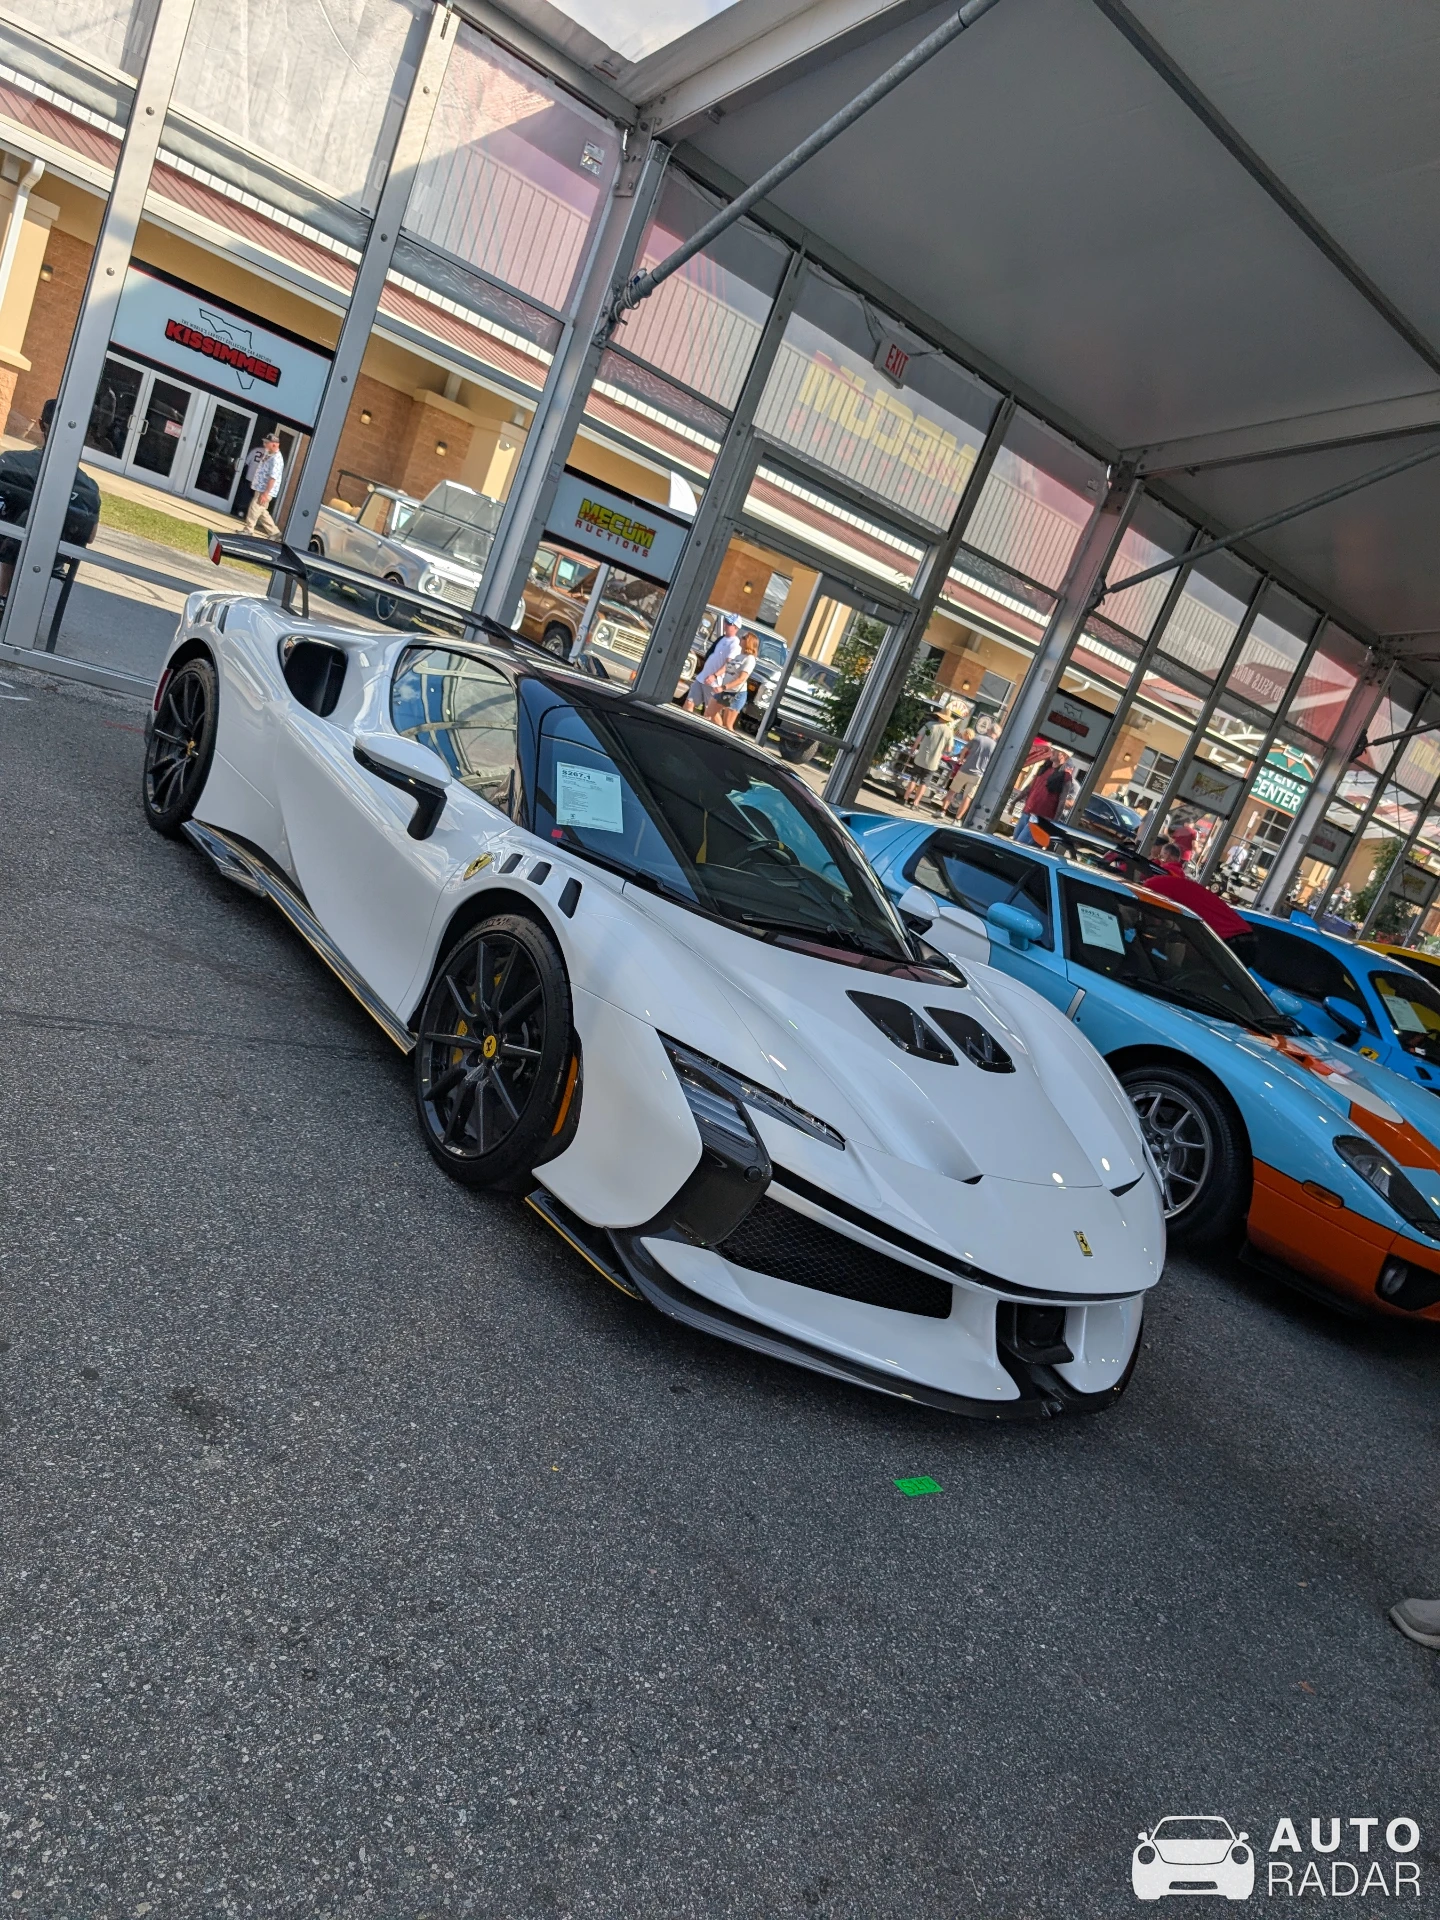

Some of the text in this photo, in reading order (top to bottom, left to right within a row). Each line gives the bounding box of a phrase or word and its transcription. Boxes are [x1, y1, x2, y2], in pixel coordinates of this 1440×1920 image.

[165, 319, 281, 387] KISSIMMEE
[884, 343, 910, 379] EXIT
[574, 519, 649, 558] AUCTIONS
[577, 498, 656, 550] MECUM
[1250, 777, 1302, 812] CENTER
